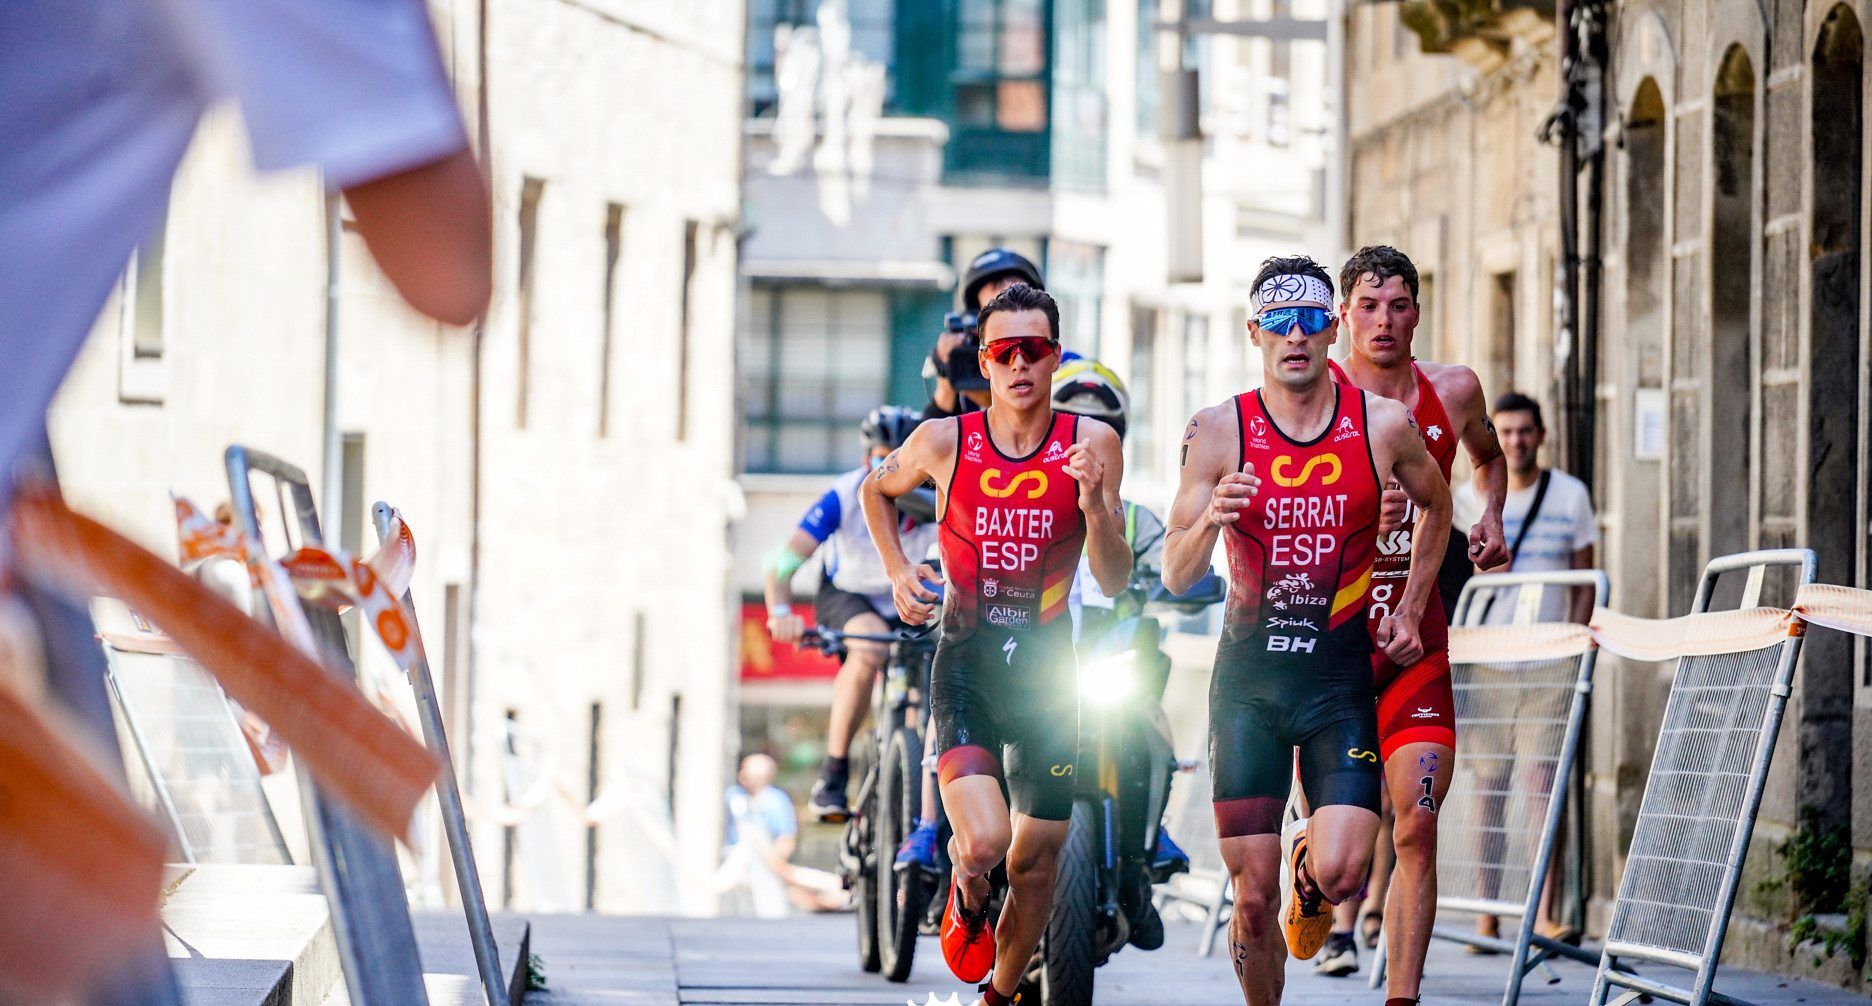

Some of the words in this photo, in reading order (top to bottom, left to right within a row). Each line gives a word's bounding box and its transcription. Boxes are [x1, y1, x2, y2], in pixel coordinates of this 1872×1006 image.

[1042, 452, 1069, 463] austra
[1263, 494, 1348, 530] SERRAT
[975, 506, 1054, 539] BAXTER
[981, 541, 1039, 572] ESP
[1270, 533, 1336, 566] ESP
[1006, 589, 1035, 599] Ceuta
[1289, 594, 1328, 606] Ibiza
[988, 613, 1028, 625] Garden
[989, 606, 1029, 619] Albir
[1266, 635, 1318, 654] BH
